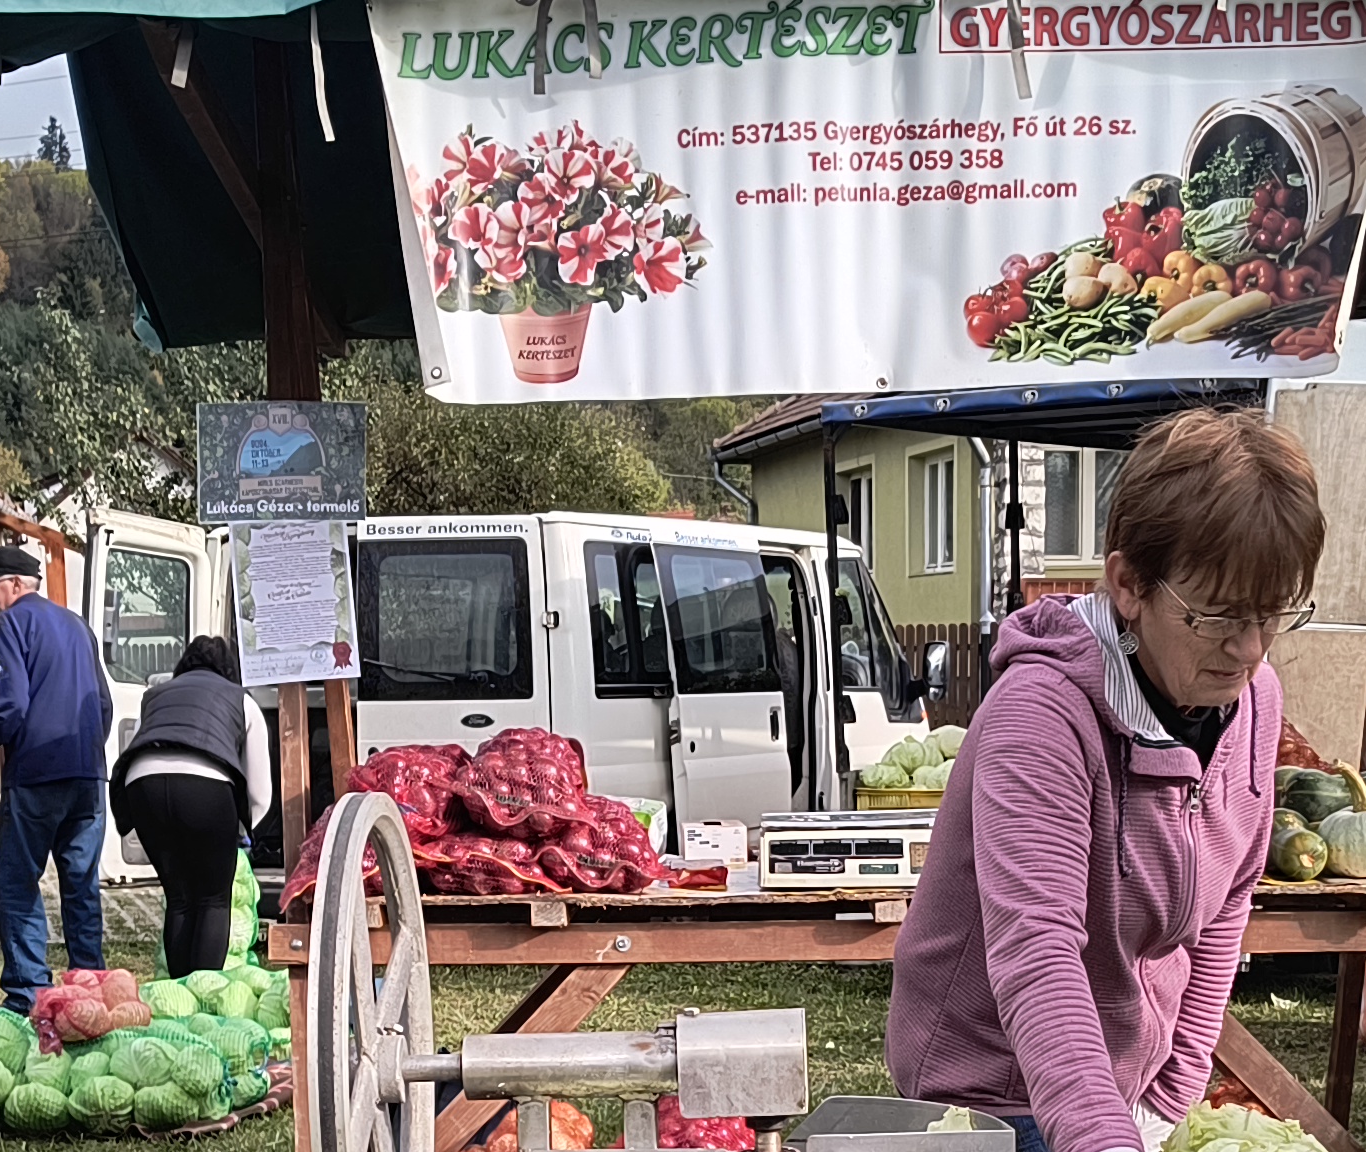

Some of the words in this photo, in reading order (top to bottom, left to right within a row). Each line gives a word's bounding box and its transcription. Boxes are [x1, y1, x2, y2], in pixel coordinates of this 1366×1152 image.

[677, 126, 725, 148] Cím:
[732, 121, 817, 145] 537135
[823, 118, 1005, 146] Gyergyószárhegy,
[1013, 116, 1038, 137] Fő
[1045, 116, 1066, 137] út
[1073, 116, 1102, 136] 26
[1108, 119, 1137, 136] sz.
[808, 152, 843, 171] Tel:
[849, 151, 903, 171] 0745
[909, 150, 953, 171] 059
[959, 149, 1003, 170] 358
[735, 183, 806, 205] e-mail:
[814, 179, 1077, 206] petunia.geza@gmail.com
[206, 500, 253, 515] Lukács
[257, 499, 294, 513] Géza
[306, 499, 360, 513] termelő
[366, 524, 422, 536] Besser
[427, 522, 529, 535] ankommen.
